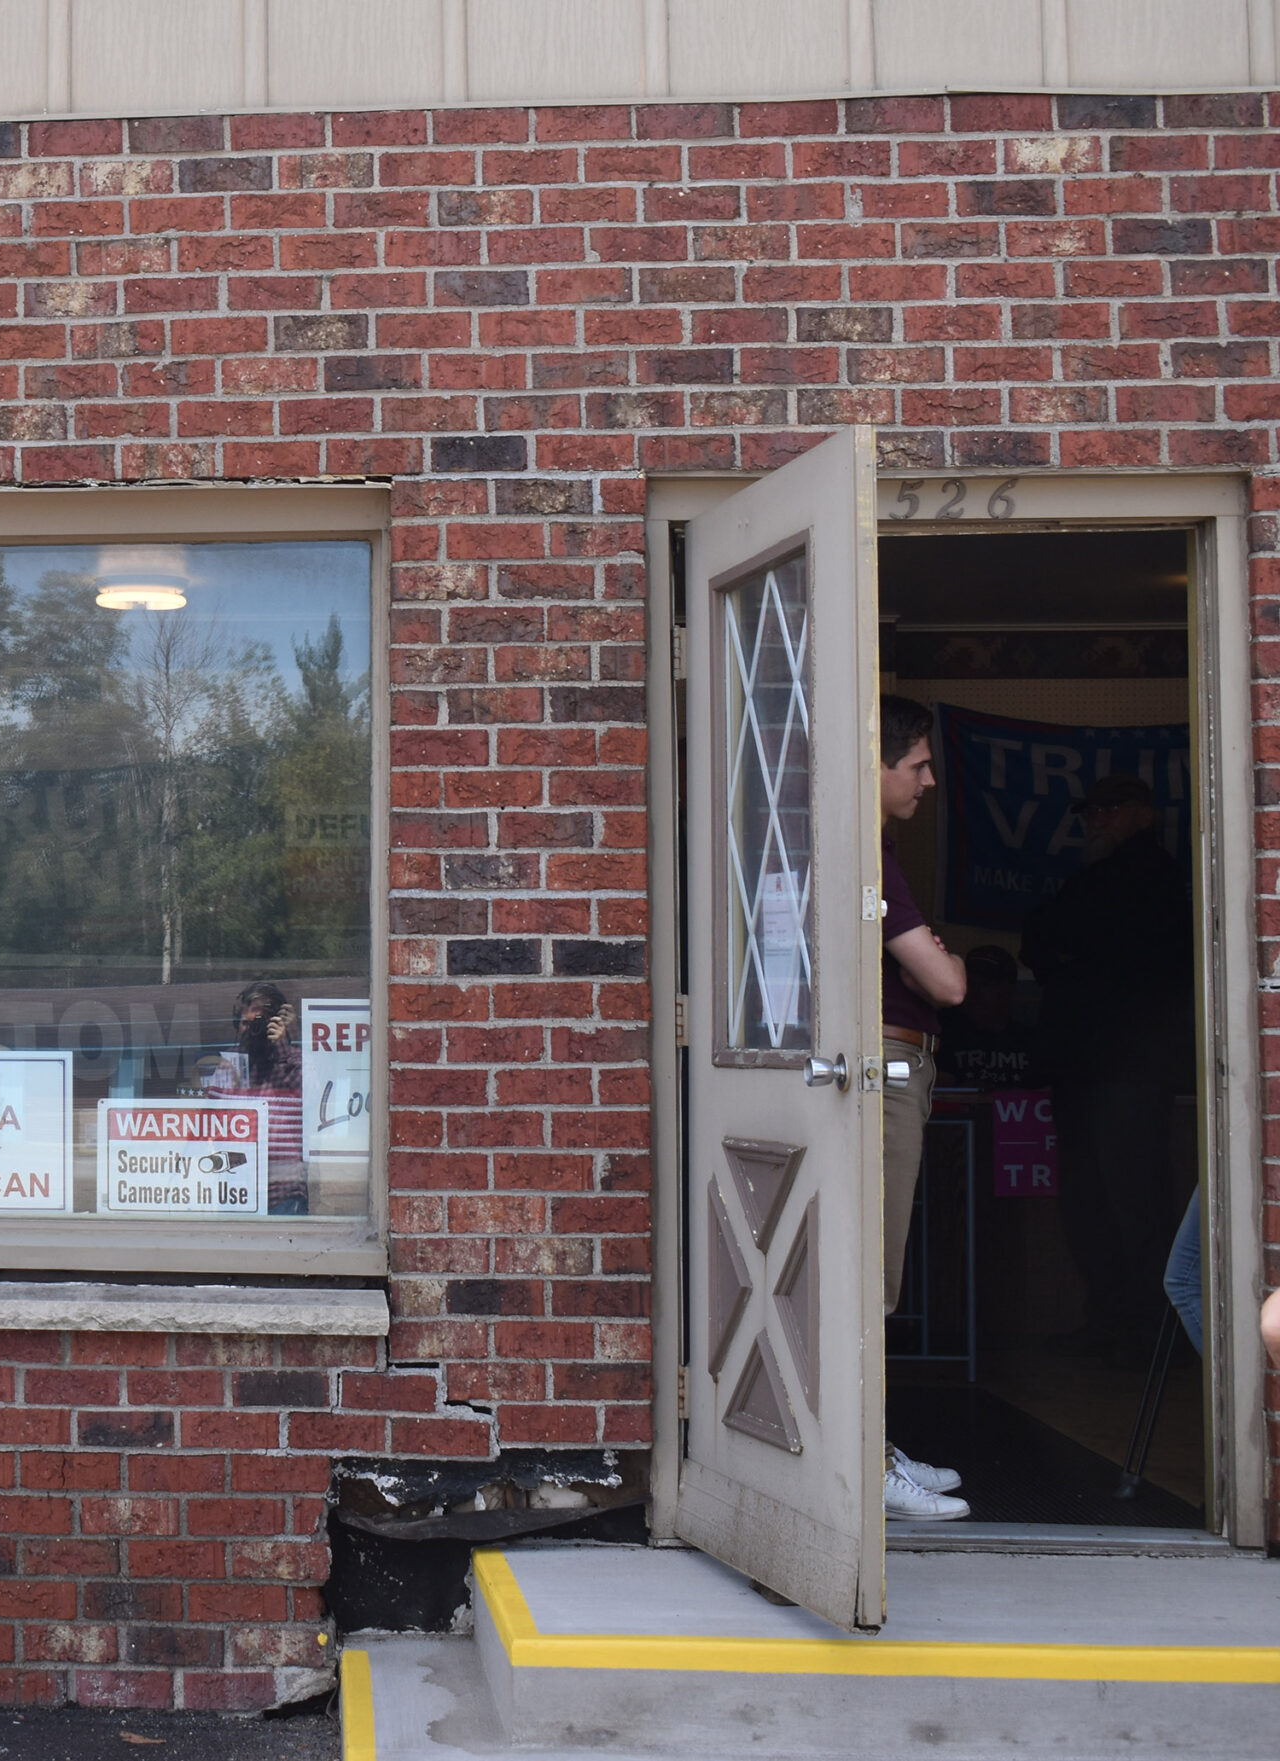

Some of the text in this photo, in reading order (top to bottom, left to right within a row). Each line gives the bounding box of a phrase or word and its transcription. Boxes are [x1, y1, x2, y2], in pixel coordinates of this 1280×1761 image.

[889, 478, 1020, 519] 526
[973, 865, 1033, 894] MAKE
[116, 1113, 250, 1138] WARNING
[118, 1150, 192, 1178] Security
[118, 1180, 190, 1204] Cameras
[197, 1181, 212, 1204] In
[219, 1181, 248, 1205] Use
